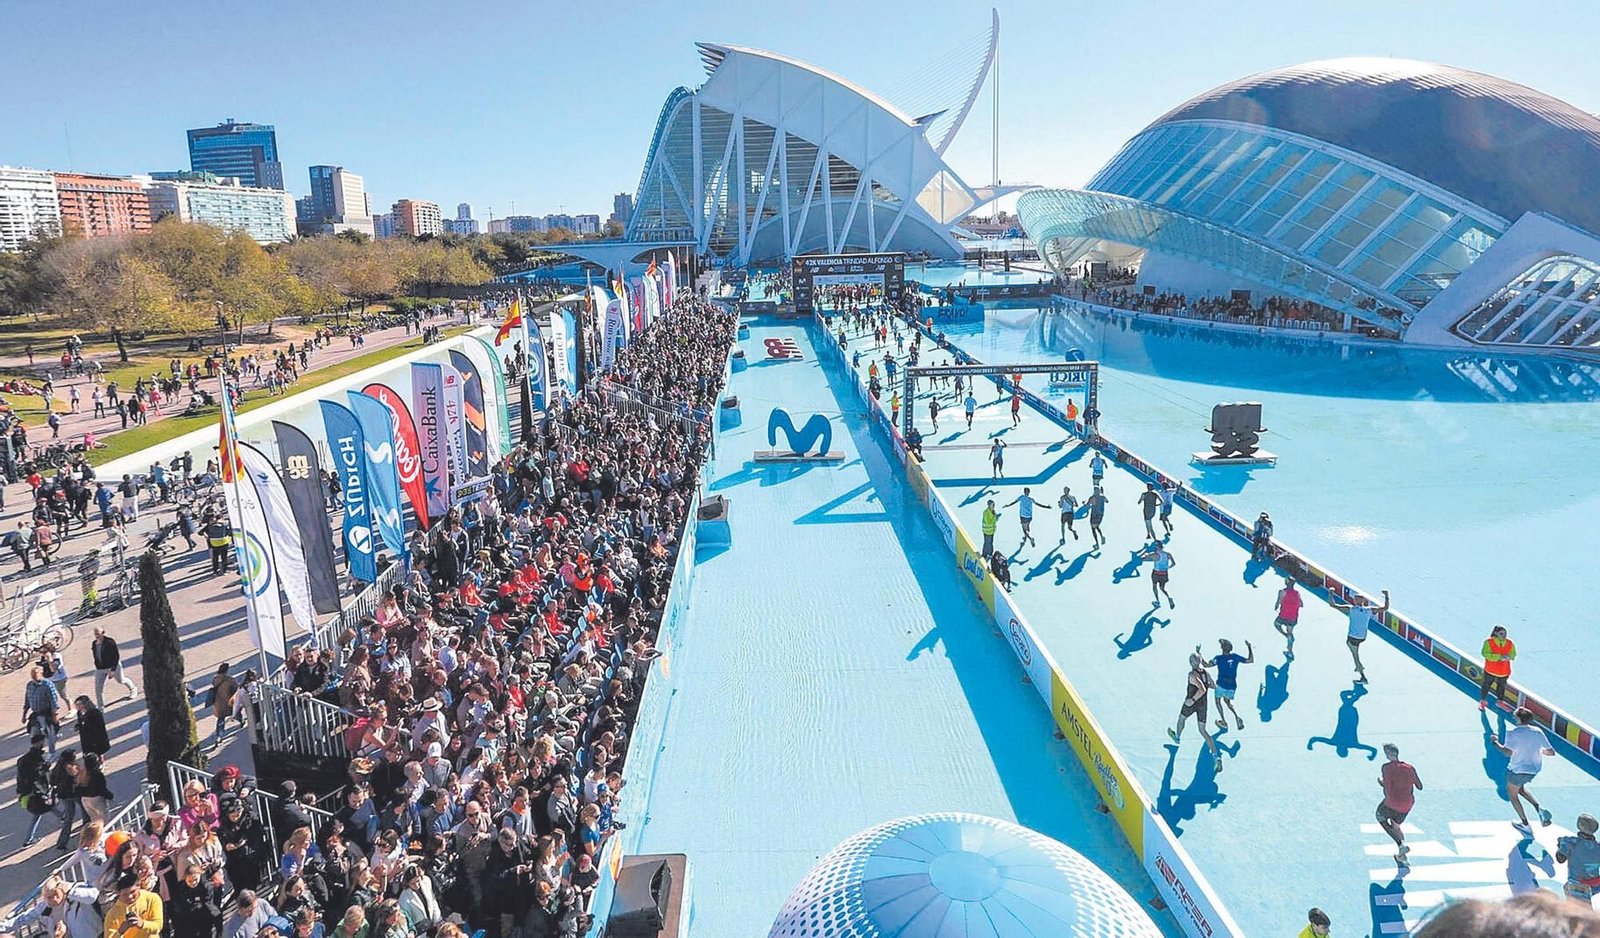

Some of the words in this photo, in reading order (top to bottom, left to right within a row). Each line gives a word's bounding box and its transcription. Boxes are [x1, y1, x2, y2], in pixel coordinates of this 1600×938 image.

[817, 258, 843, 266] VALENCIA
[868, 256, 893, 264] ALFONSO
[421, 386, 439, 474] CaixaBank
[1061, 702, 1094, 761] AMSTEL
